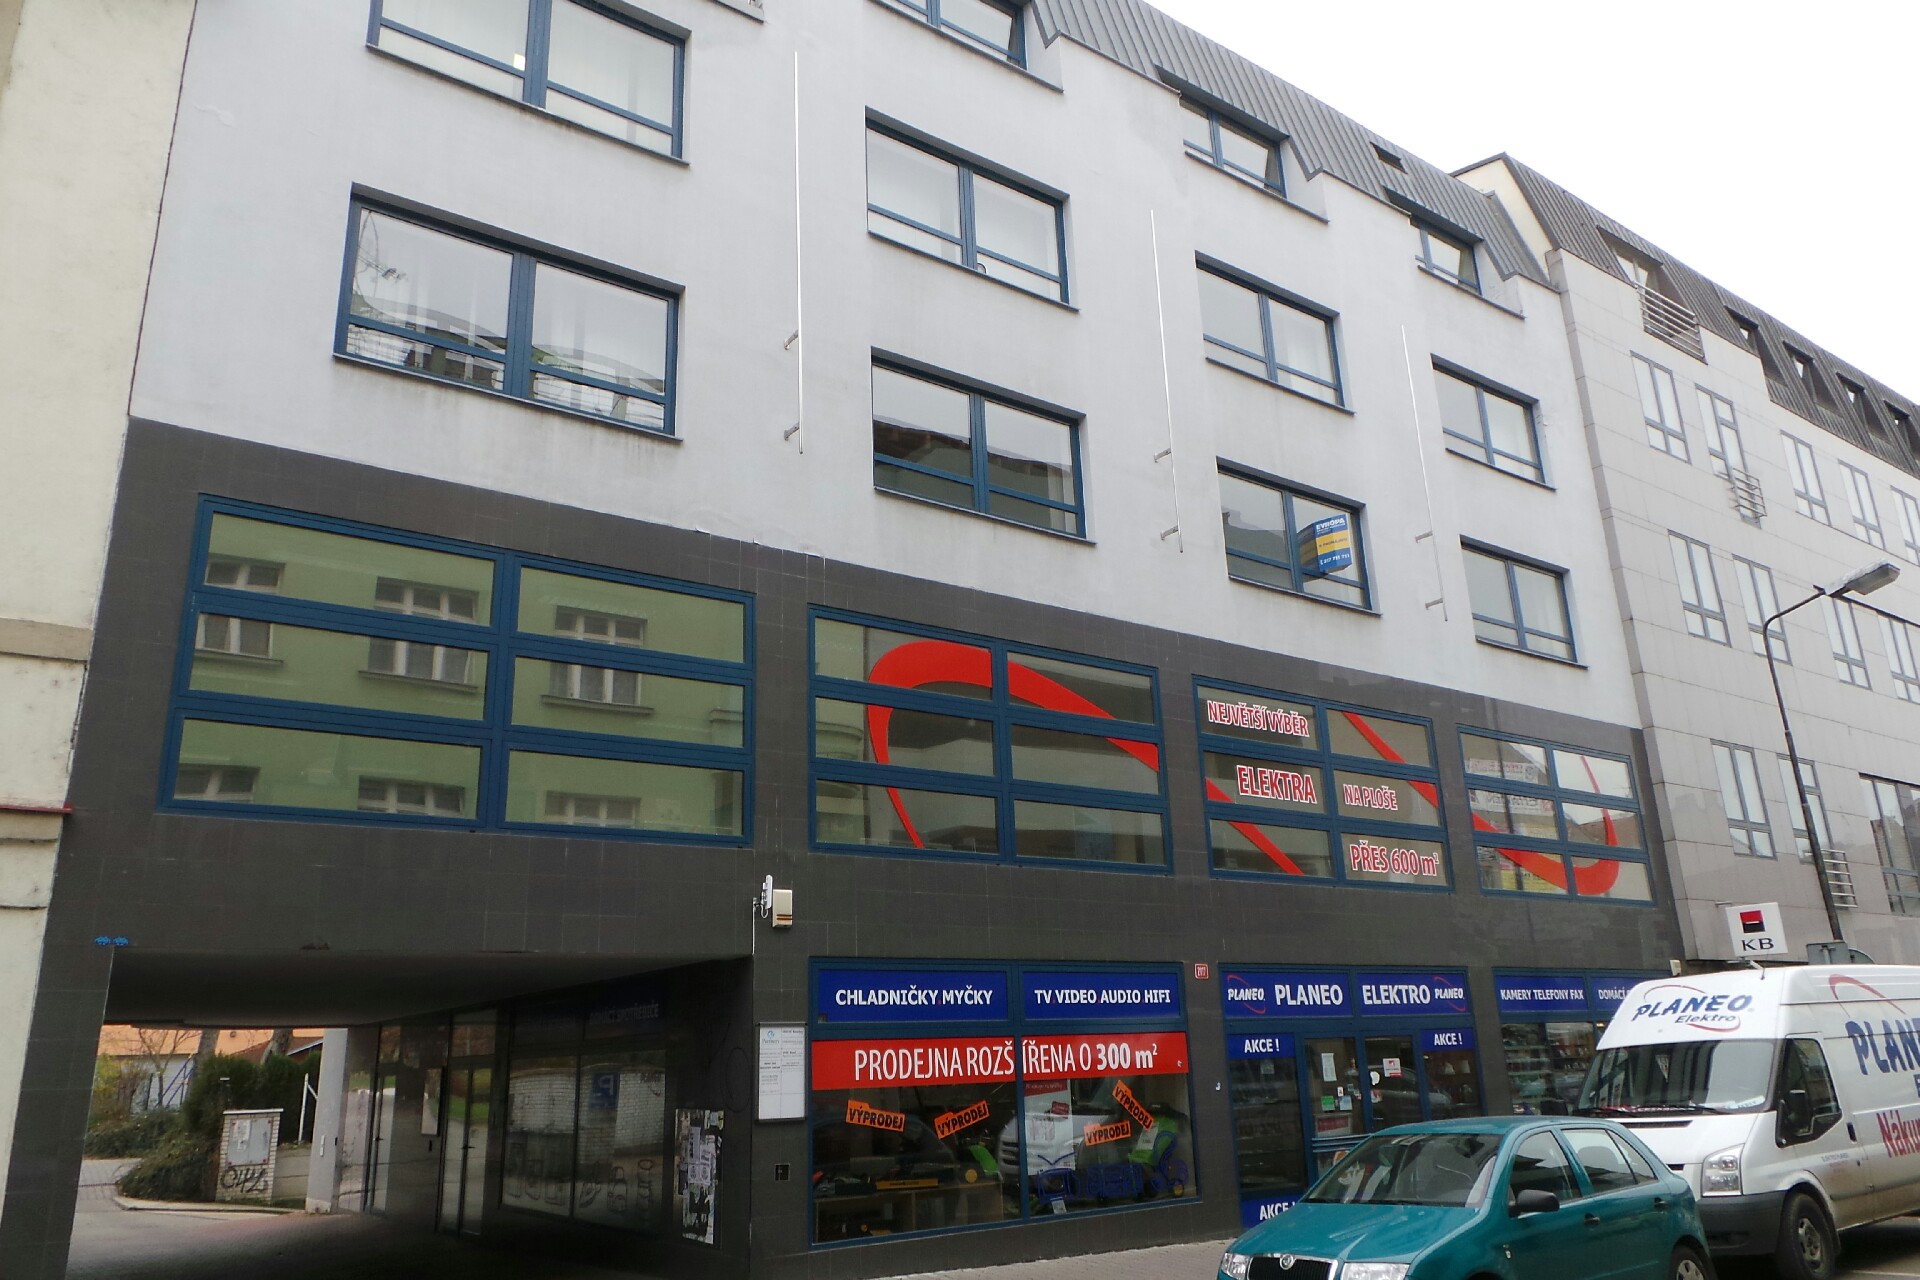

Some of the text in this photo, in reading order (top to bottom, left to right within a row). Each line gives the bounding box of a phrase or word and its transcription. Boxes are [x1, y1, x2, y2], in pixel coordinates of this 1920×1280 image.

[1316, 517, 1345, 530] EVROPA
[1207, 700, 1310, 737] NEJVĚTŠÍ VÝBĚR
[1237, 765, 1318, 804] ELEKTRA
[1343, 784, 1398, 810] NA PLOŠE
[1350, 840, 1390, 873] PŘES
[1390, 848, 1419, 875] 600
[1742, 938, 1774, 951] KB
[835, 985, 993, 1005] CHLADNIČKY MYČKY
[1034, 989, 1171, 1004] TV VIDEO AUDIO HIFI
[1227, 988, 1264, 1001] PLANEO
[1274, 984, 1431, 1006] PLANEO ELEKTRO
[1435, 988, 1464, 999] PLANEO
[1500, 989, 1584, 1000] KAMERY TELEFONY FAX
[1598, 986, 1626, 1000] DOMÁCÍ
[1631, 994, 1753, 1022] PLANEO
[1675, 1014, 1736, 1024] Elektro
[1244, 1038, 1274, 1053] AKCE
[1434, 1032, 1457, 1046] AKCE
[855, 1047, 963, 1081] PRODEJNA
[1079, 1043, 1092, 1071] O
[1096, 1042, 1131, 1070] 300
[849, 1105, 903, 1129] VÝPRODEJ
[1115, 1086, 1153, 1129] VÝPRODEJ
[937, 1103, 988, 1135] VÝPRODEJ
[1086, 1124, 1130, 1143] VÝPRODEJ
